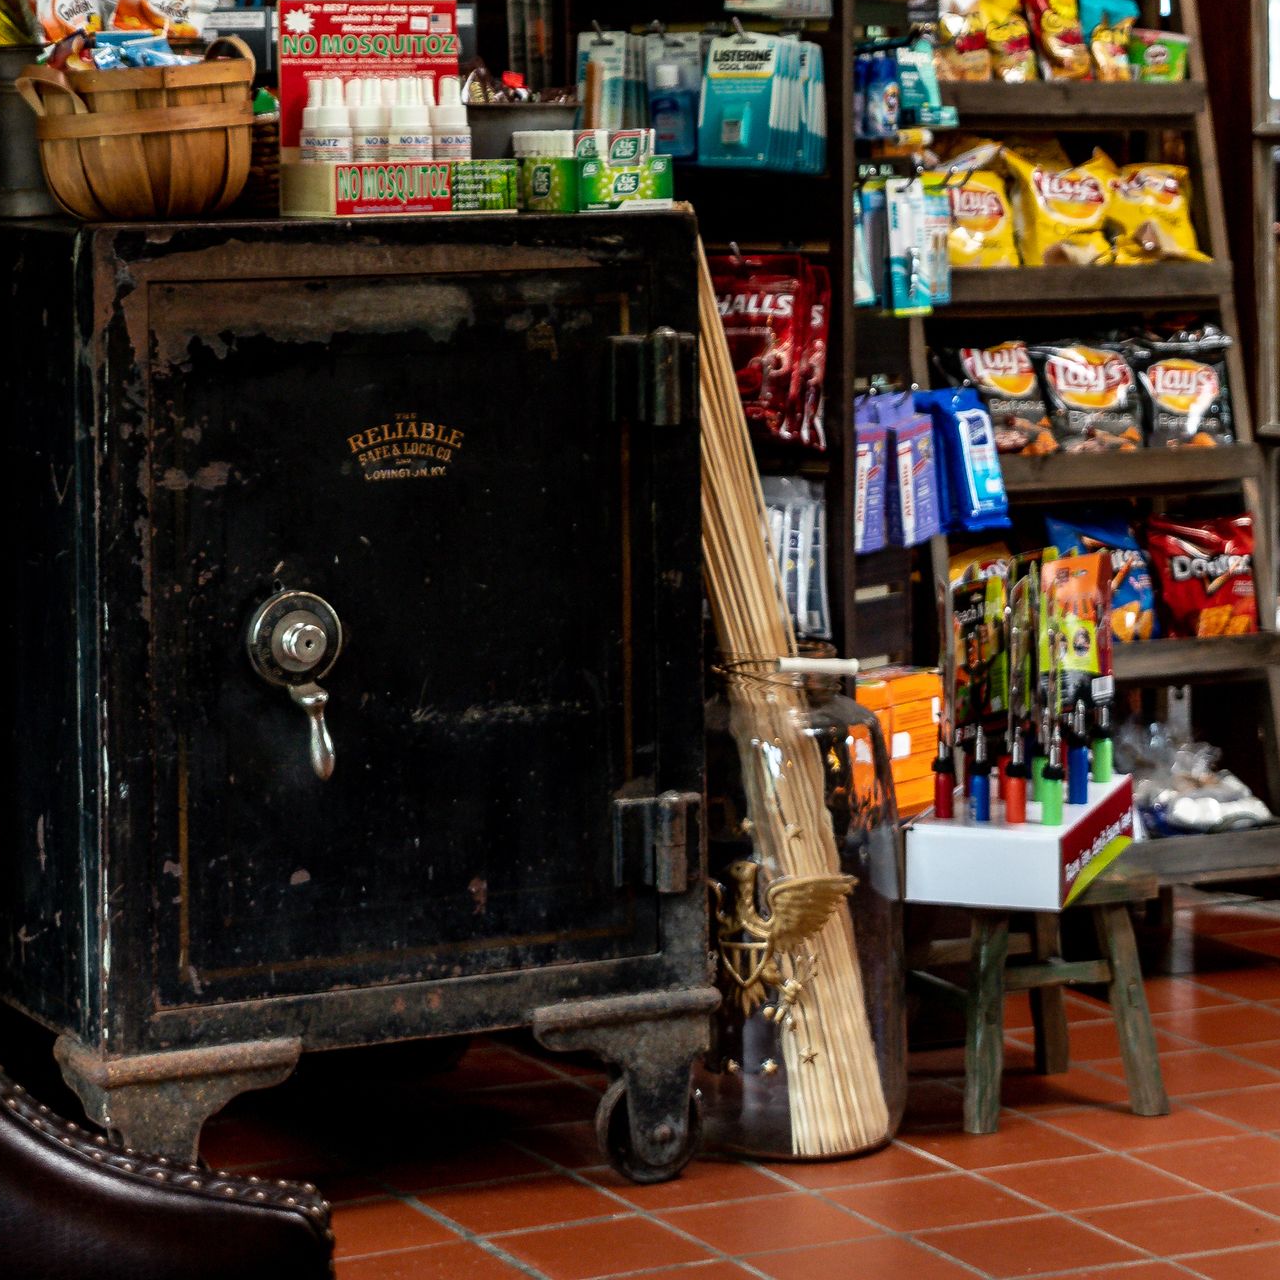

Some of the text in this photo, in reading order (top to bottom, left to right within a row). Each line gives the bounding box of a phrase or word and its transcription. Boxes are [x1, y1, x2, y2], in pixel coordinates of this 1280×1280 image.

[303, 4, 435, 15] The BEST personal bug spray
[372, 15, 382, 23] to
[282, 34, 458, 58] NO MOSQUITOZ
[713, 49, 773, 63] LISTERINE
[717, 62, 764, 71] COOL MINT
[619, 137, 637, 148] tic
[616, 147, 635, 157] tac
[338, 165, 451, 204] NO MOSQUITOZ
[621, 174, 637, 183] tic
[617, 182, 637, 191] tac
[715, 293, 795, 317] HALLS
[990, 398, 1045, 413] Barbecue
[346, 421, 464, 453] RELIABLE
[359, 444, 392, 466] SAFE
[392, 443, 401, 456] &
[403, 442, 436, 457] LOCK
